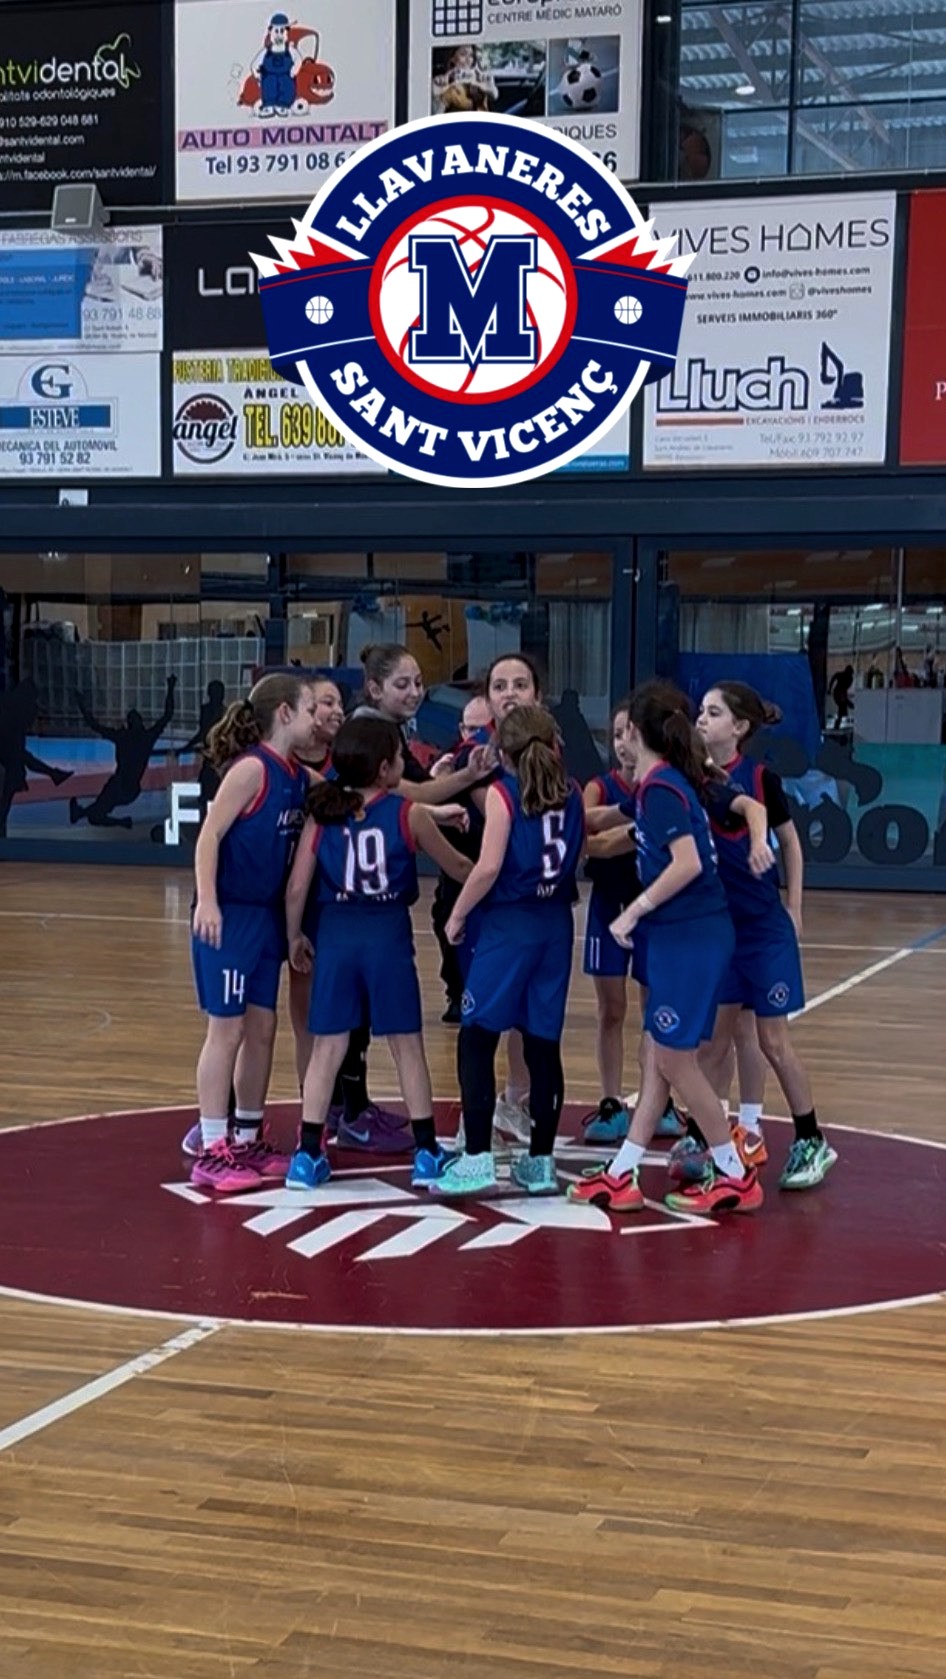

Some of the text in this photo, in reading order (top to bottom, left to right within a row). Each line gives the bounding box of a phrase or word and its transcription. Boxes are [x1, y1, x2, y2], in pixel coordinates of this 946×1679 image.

[487, 10, 532, 25] CENTRE
[181, 123, 387, 149] AUTO MONTALT
[206, 154, 232, 175] Tel
[237, 155, 260, 174] 93
[266, 153, 298, 172] 791
[306, 152, 330, 170] 08
[697, 313, 736, 324] SERVEIS
[739, 310, 813, 322] IMMOBILIARIS
[173, 415, 239, 449] angel
[243, 404, 279, 449] TEL.
[281, 402, 314, 449] 639
[19, 451, 91, 466] 93 791 52 82
[44, 440, 61, 451] DEL
[541, 810, 567, 879] 5
[344, 827, 390, 895] 19
[222, 968, 246, 1005] 14
